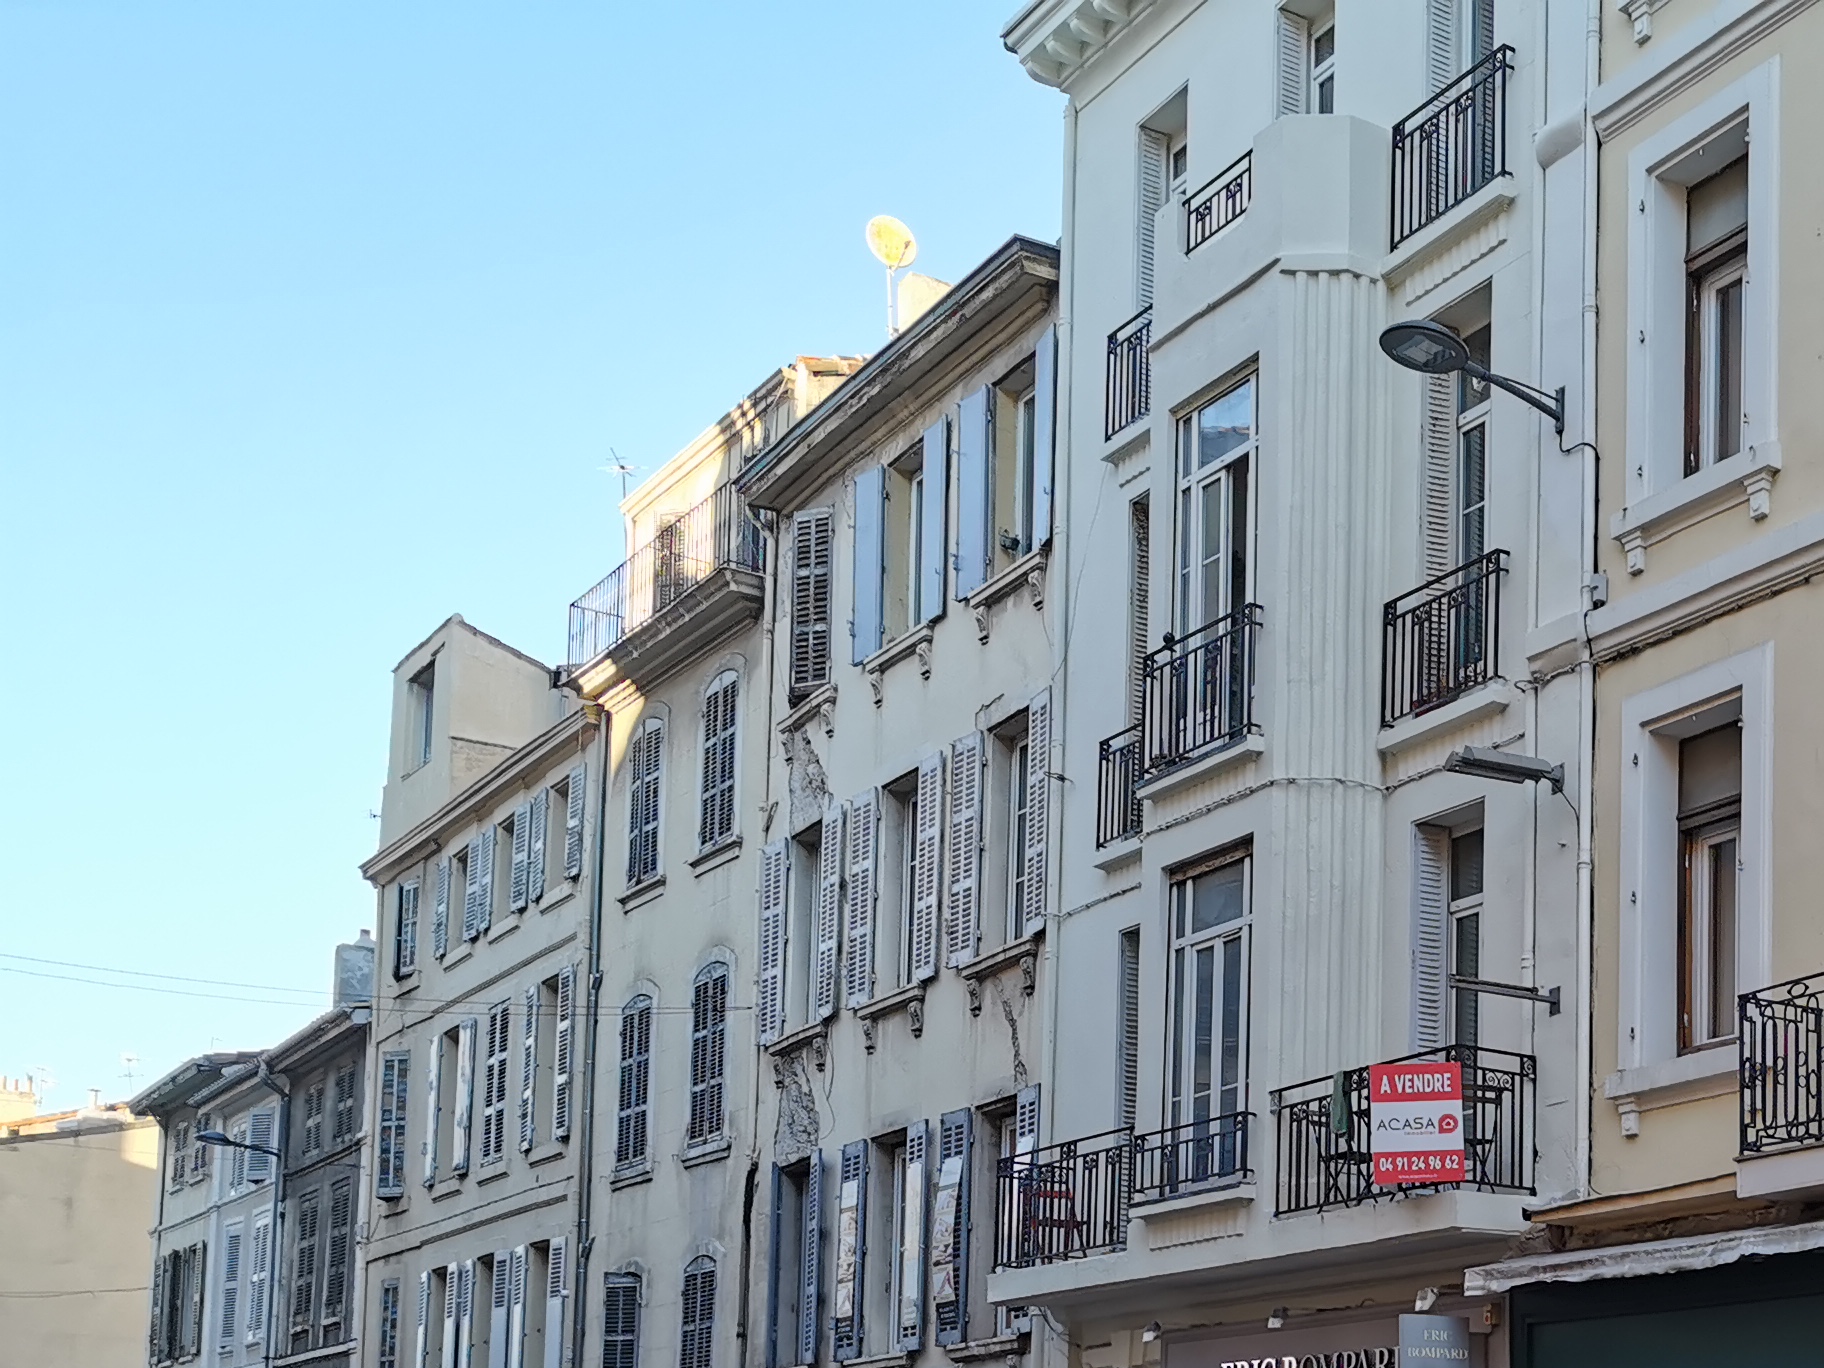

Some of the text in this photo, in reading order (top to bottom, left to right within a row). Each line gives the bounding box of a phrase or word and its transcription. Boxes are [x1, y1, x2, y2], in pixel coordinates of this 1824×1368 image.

[1380, 1072, 1452, 1095] A VENDRE
[1376, 1116, 1436, 1131] ACASA
[1379, 1154, 1460, 1171] 04 91 24 96 62
[1423, 1329, 1453, 1341] ERIC
[1407, 1346, 1469, 1359] BOMPARD
